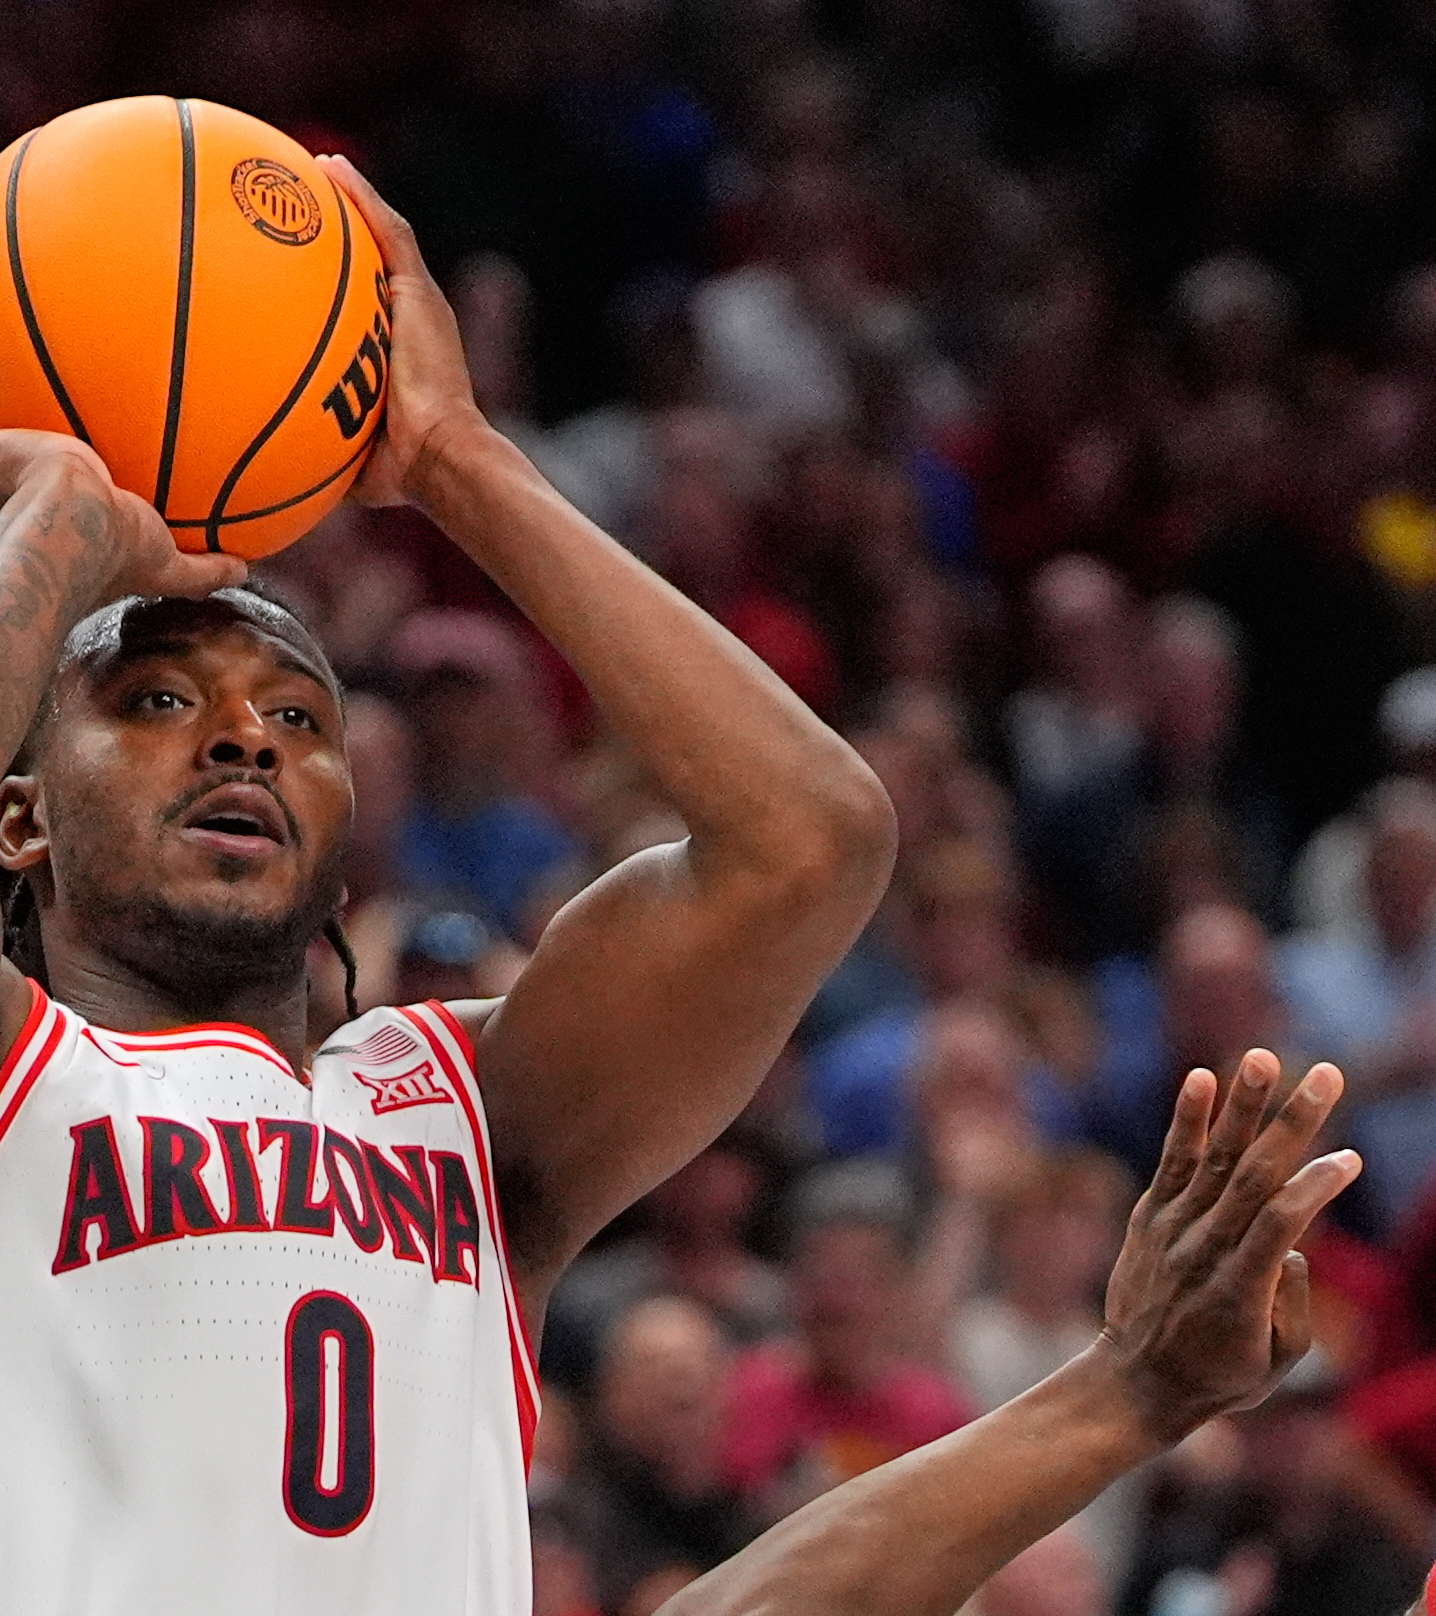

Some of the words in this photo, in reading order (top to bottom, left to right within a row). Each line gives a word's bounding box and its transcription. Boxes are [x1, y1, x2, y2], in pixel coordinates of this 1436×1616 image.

[322, 270, 393, 440] Wil
[353, 1059, 455, 1116] XII
[52, 1114, 480, 1294] ARIZONA
[282, 1289, 374, 1538] 0
